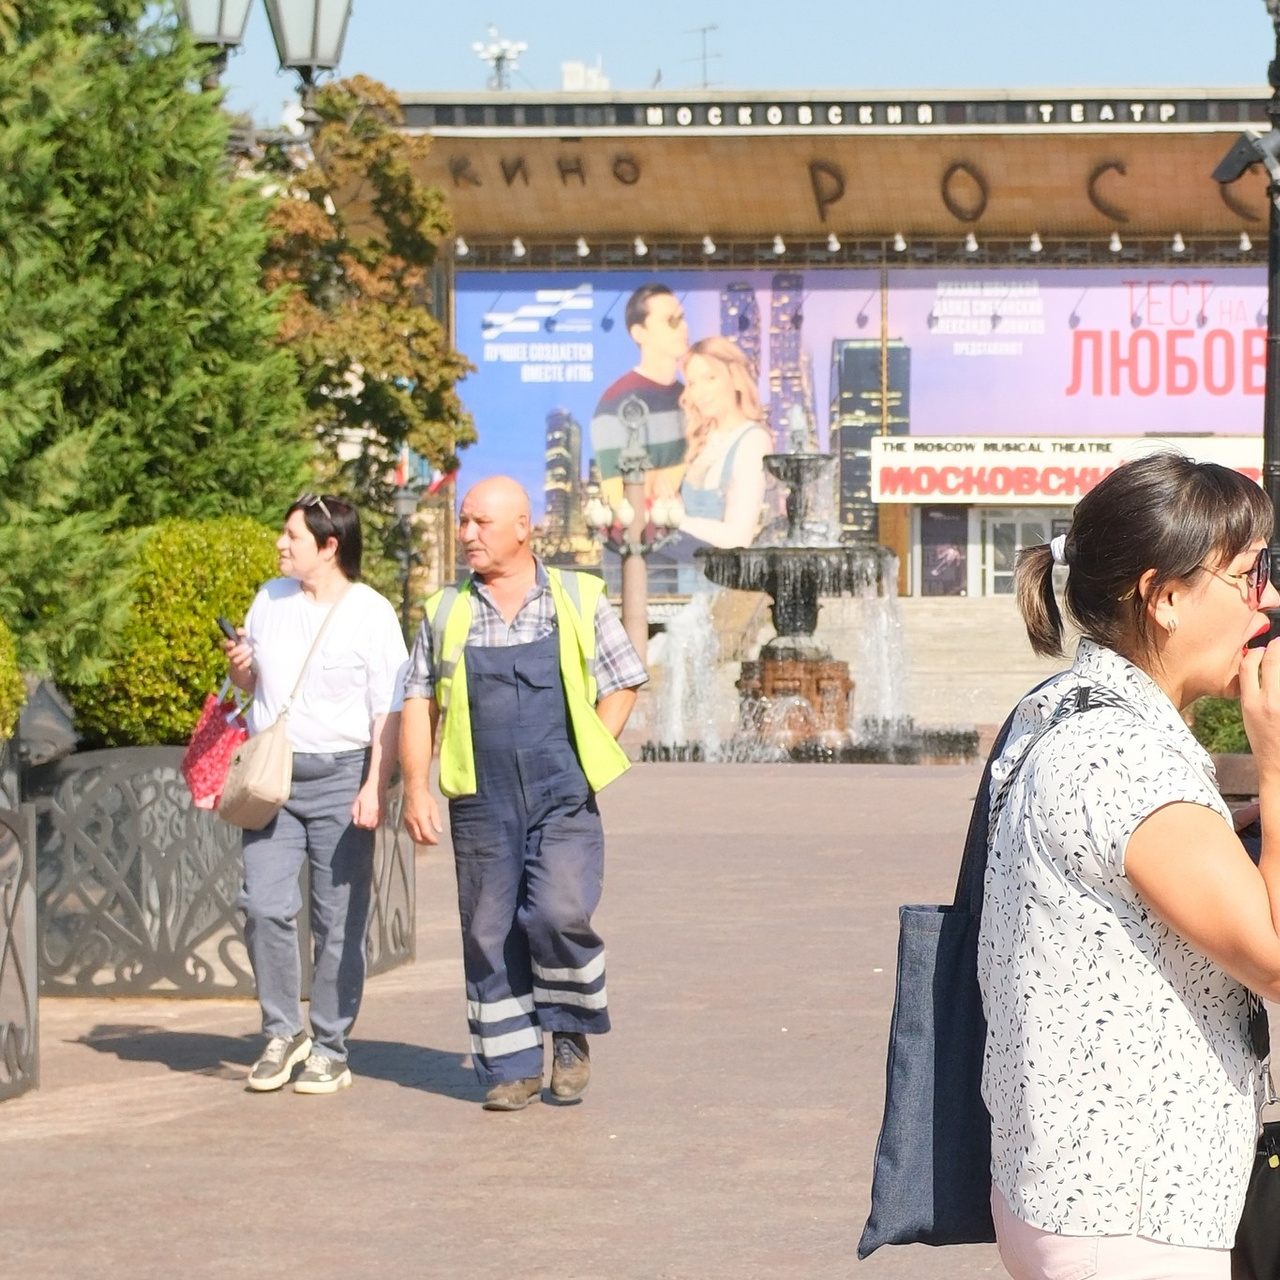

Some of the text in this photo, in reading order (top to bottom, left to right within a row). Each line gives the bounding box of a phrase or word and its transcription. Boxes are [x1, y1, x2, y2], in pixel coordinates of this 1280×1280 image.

[646, 103, 933, 125] МОСКОВСКИЙ
[1039, 103, 1177, 122] ТЕАТР
[1121, 279, 1248, 325] ТЕСТ НА
[882, 442, 1113, 453] THE MOSCOW MUSICAL THEATRE
[879, 461, 1127, 496] МОСКОВСКИ
